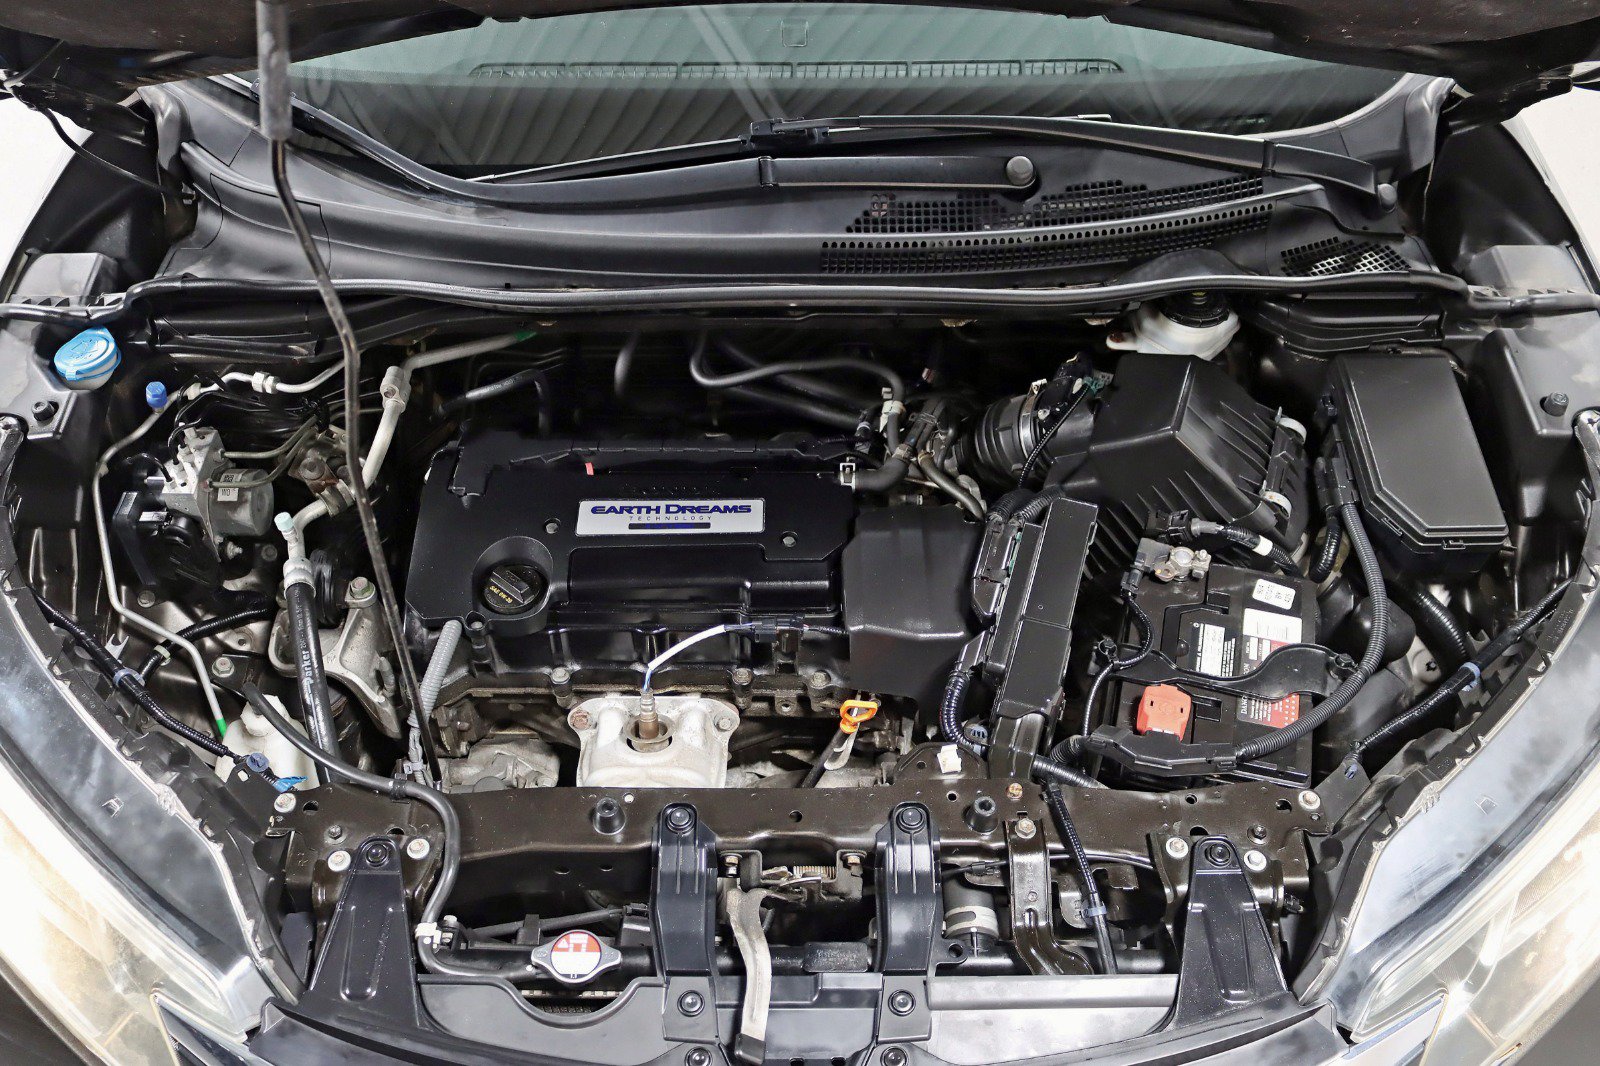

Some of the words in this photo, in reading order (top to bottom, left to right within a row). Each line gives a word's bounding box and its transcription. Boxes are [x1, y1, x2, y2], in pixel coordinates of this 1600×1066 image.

[591, 505, 661, 514] EARTH
[665, 504, 752, 514] DREAMS
[302, 650, 314, 687] Parker
